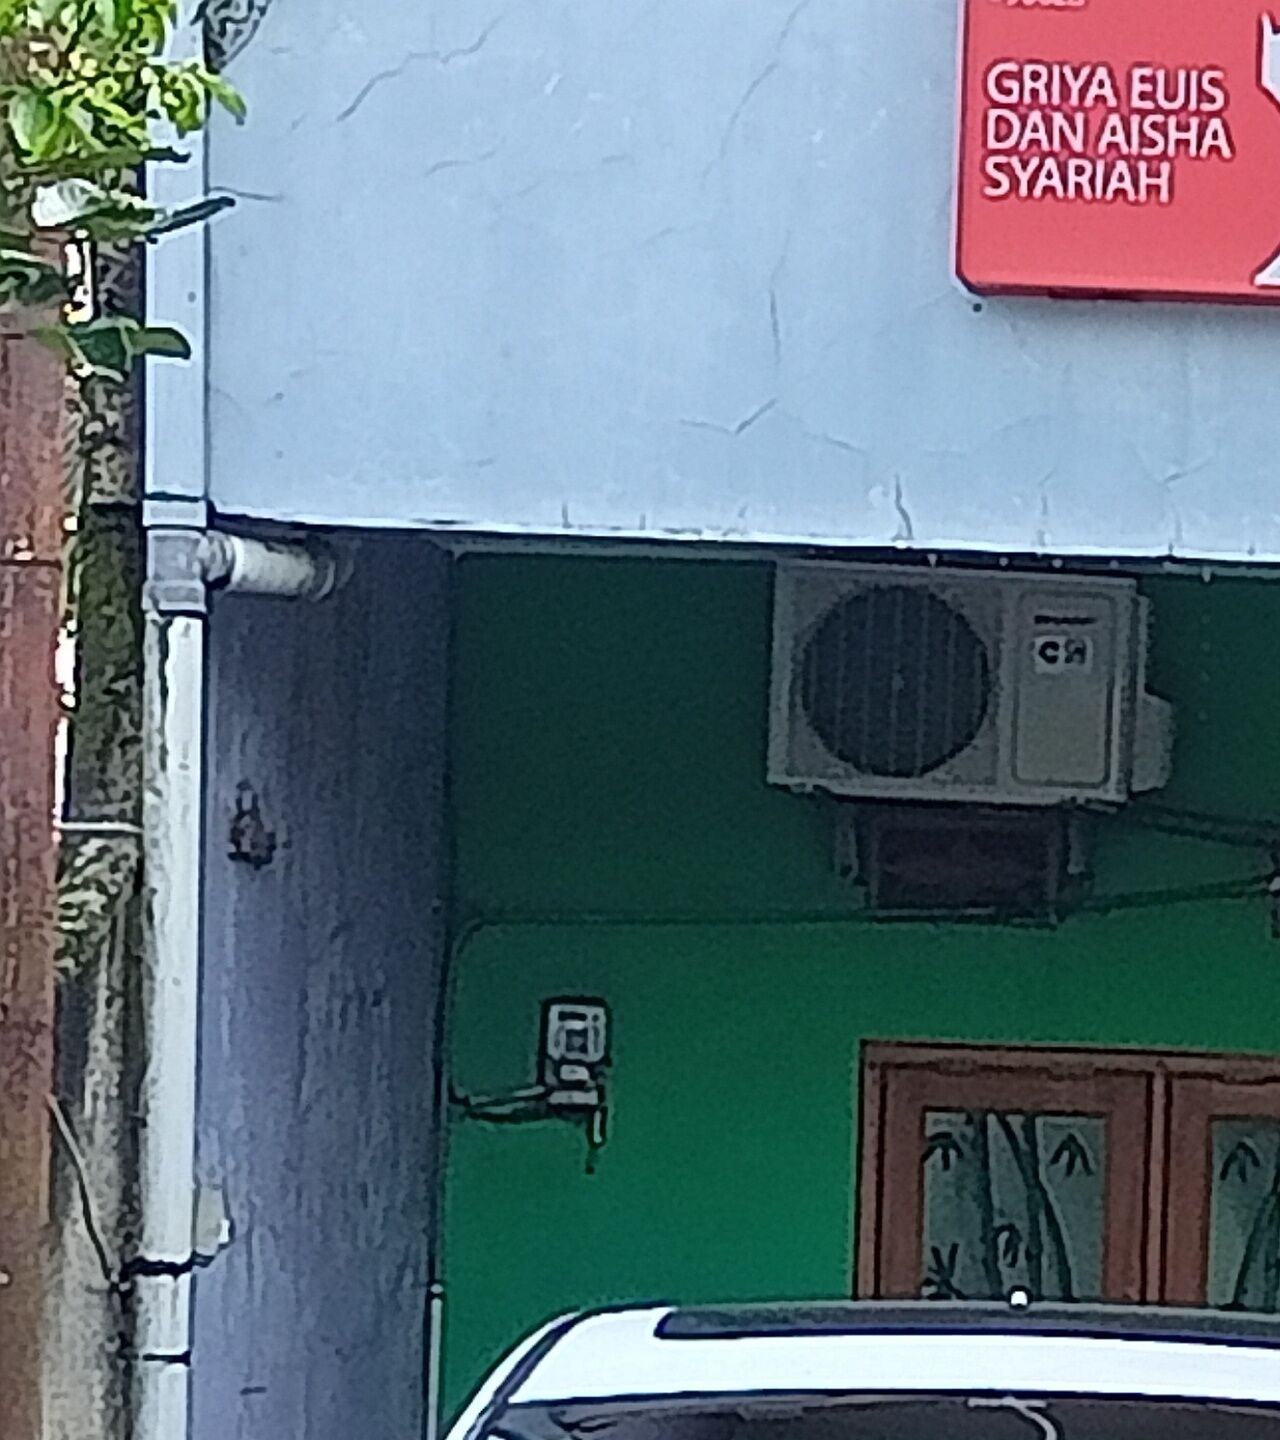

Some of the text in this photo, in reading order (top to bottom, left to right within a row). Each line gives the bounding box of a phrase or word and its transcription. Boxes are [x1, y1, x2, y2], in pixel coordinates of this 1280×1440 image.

[985, 62, 1226, 112] GRIYA EUIS
[986, 109, 1232, 158] DAN AISHA
[983, 157, 1171, 203] SYARIAH
